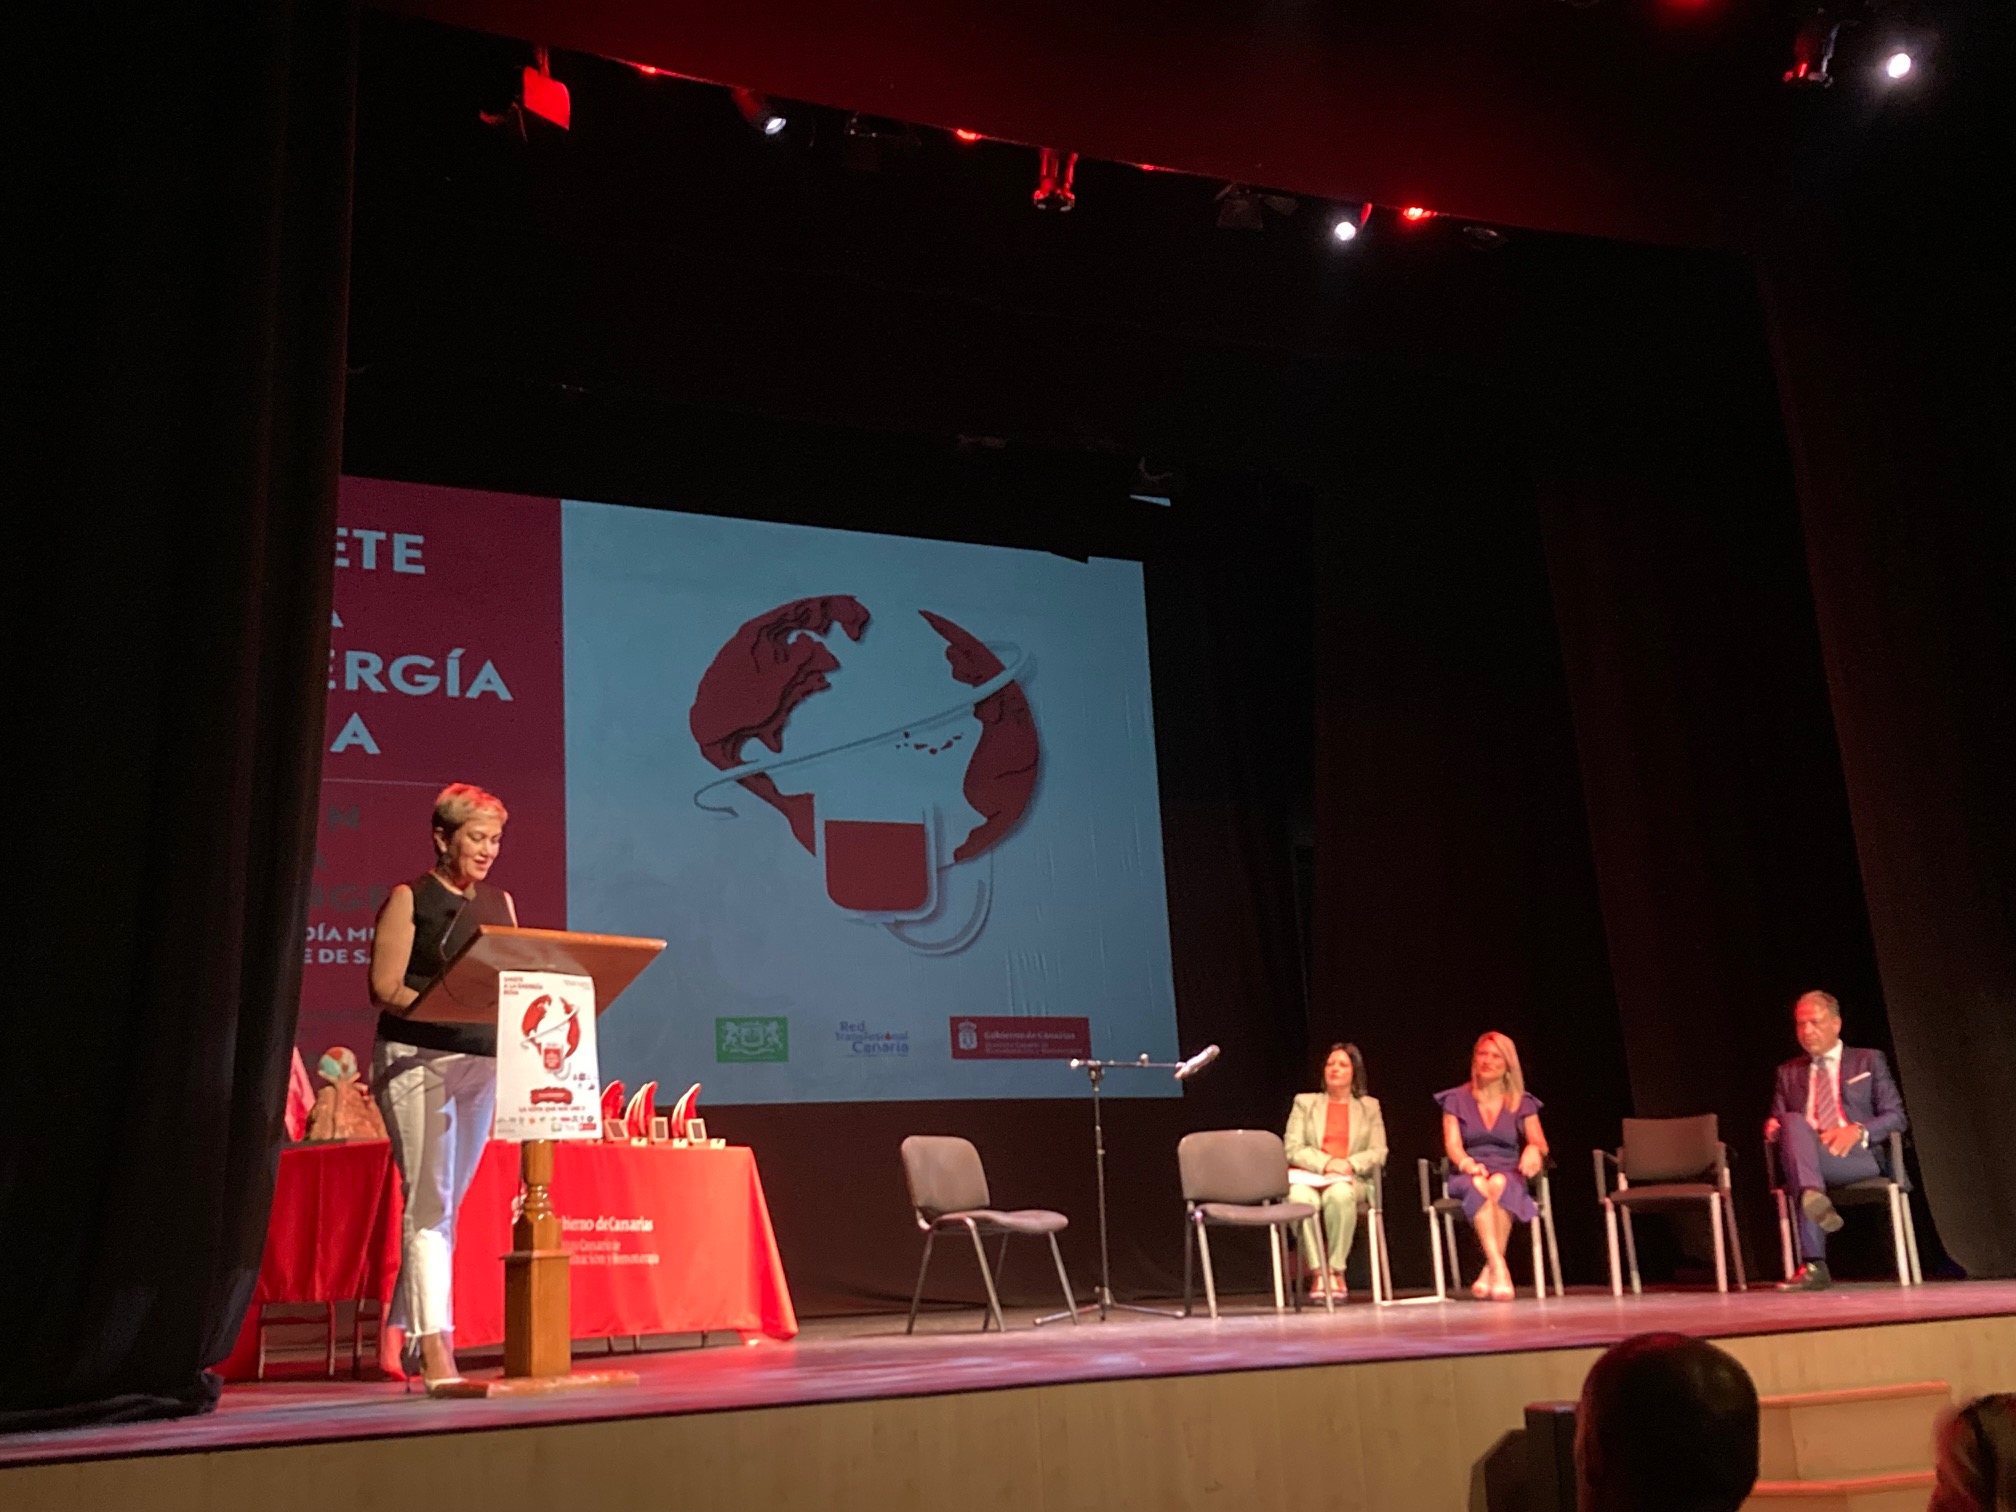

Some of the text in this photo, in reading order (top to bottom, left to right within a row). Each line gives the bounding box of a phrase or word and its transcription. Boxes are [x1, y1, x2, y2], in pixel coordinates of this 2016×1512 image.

[328, 647, 514, 701] RGÍA
[318, 948, 349, 964] DE
[353, 949, 371, 964] S
[839, 1019, 865, 1032] Red
[852, 1040, 909, 1054] Canaria
[608, 1216, 654, 1232] Canarias
